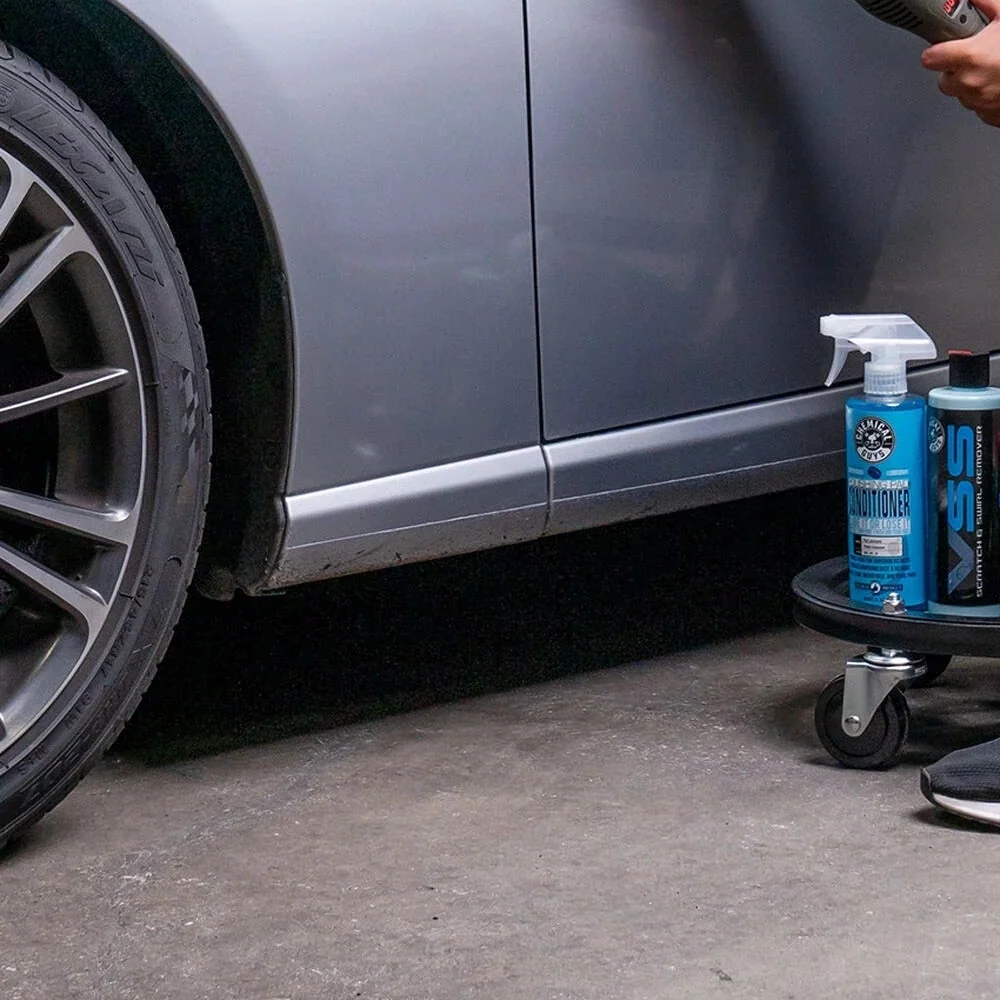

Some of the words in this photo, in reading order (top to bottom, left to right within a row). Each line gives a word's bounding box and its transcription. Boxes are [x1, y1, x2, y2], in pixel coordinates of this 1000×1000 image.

[855, 419, 893, 441] CHEMICAL
[860, 449, 886, 460] GUYS
[848, 485, 910, 518] ONDITIONER
[947, 424, 974, 595] VSS
